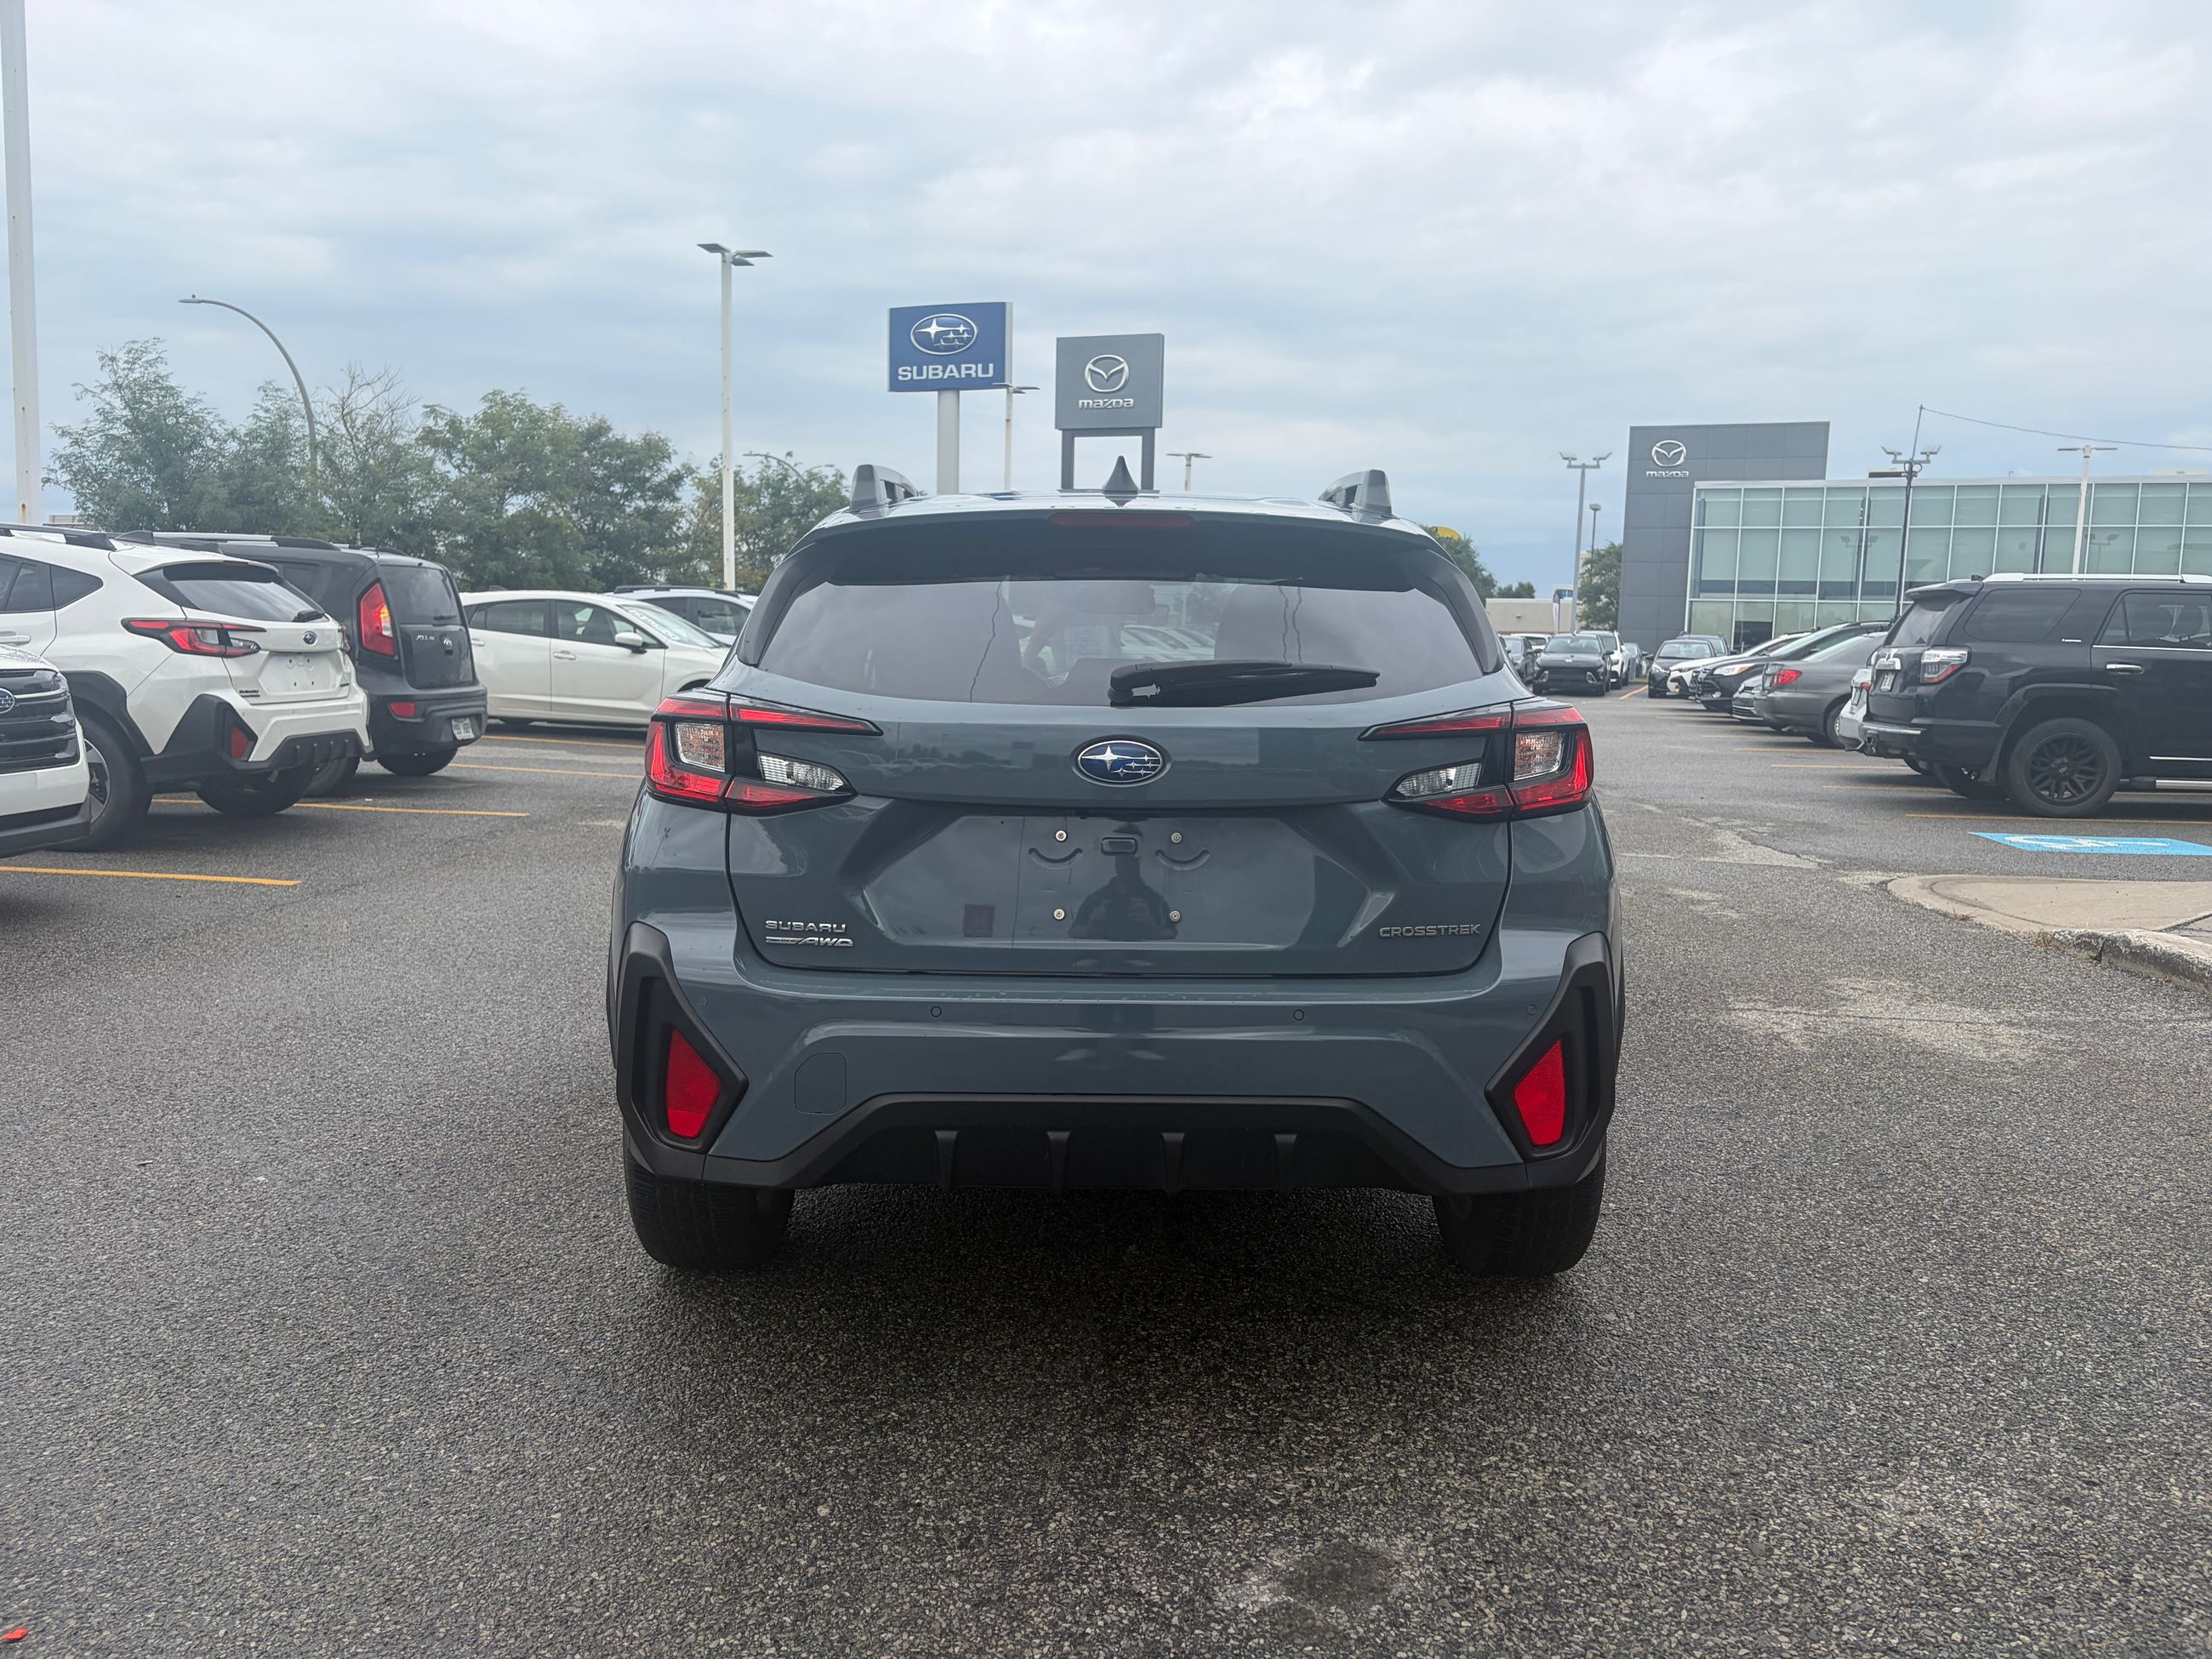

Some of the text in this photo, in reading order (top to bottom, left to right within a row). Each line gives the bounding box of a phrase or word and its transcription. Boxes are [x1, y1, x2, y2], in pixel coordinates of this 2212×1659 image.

[898, 362, 994, 381] SUBARU
[765, 920, 846, 933] SUBARU
[1379, 923, 1481, 938] CROSSTREK
[798, 937, 853, 947] AWD
